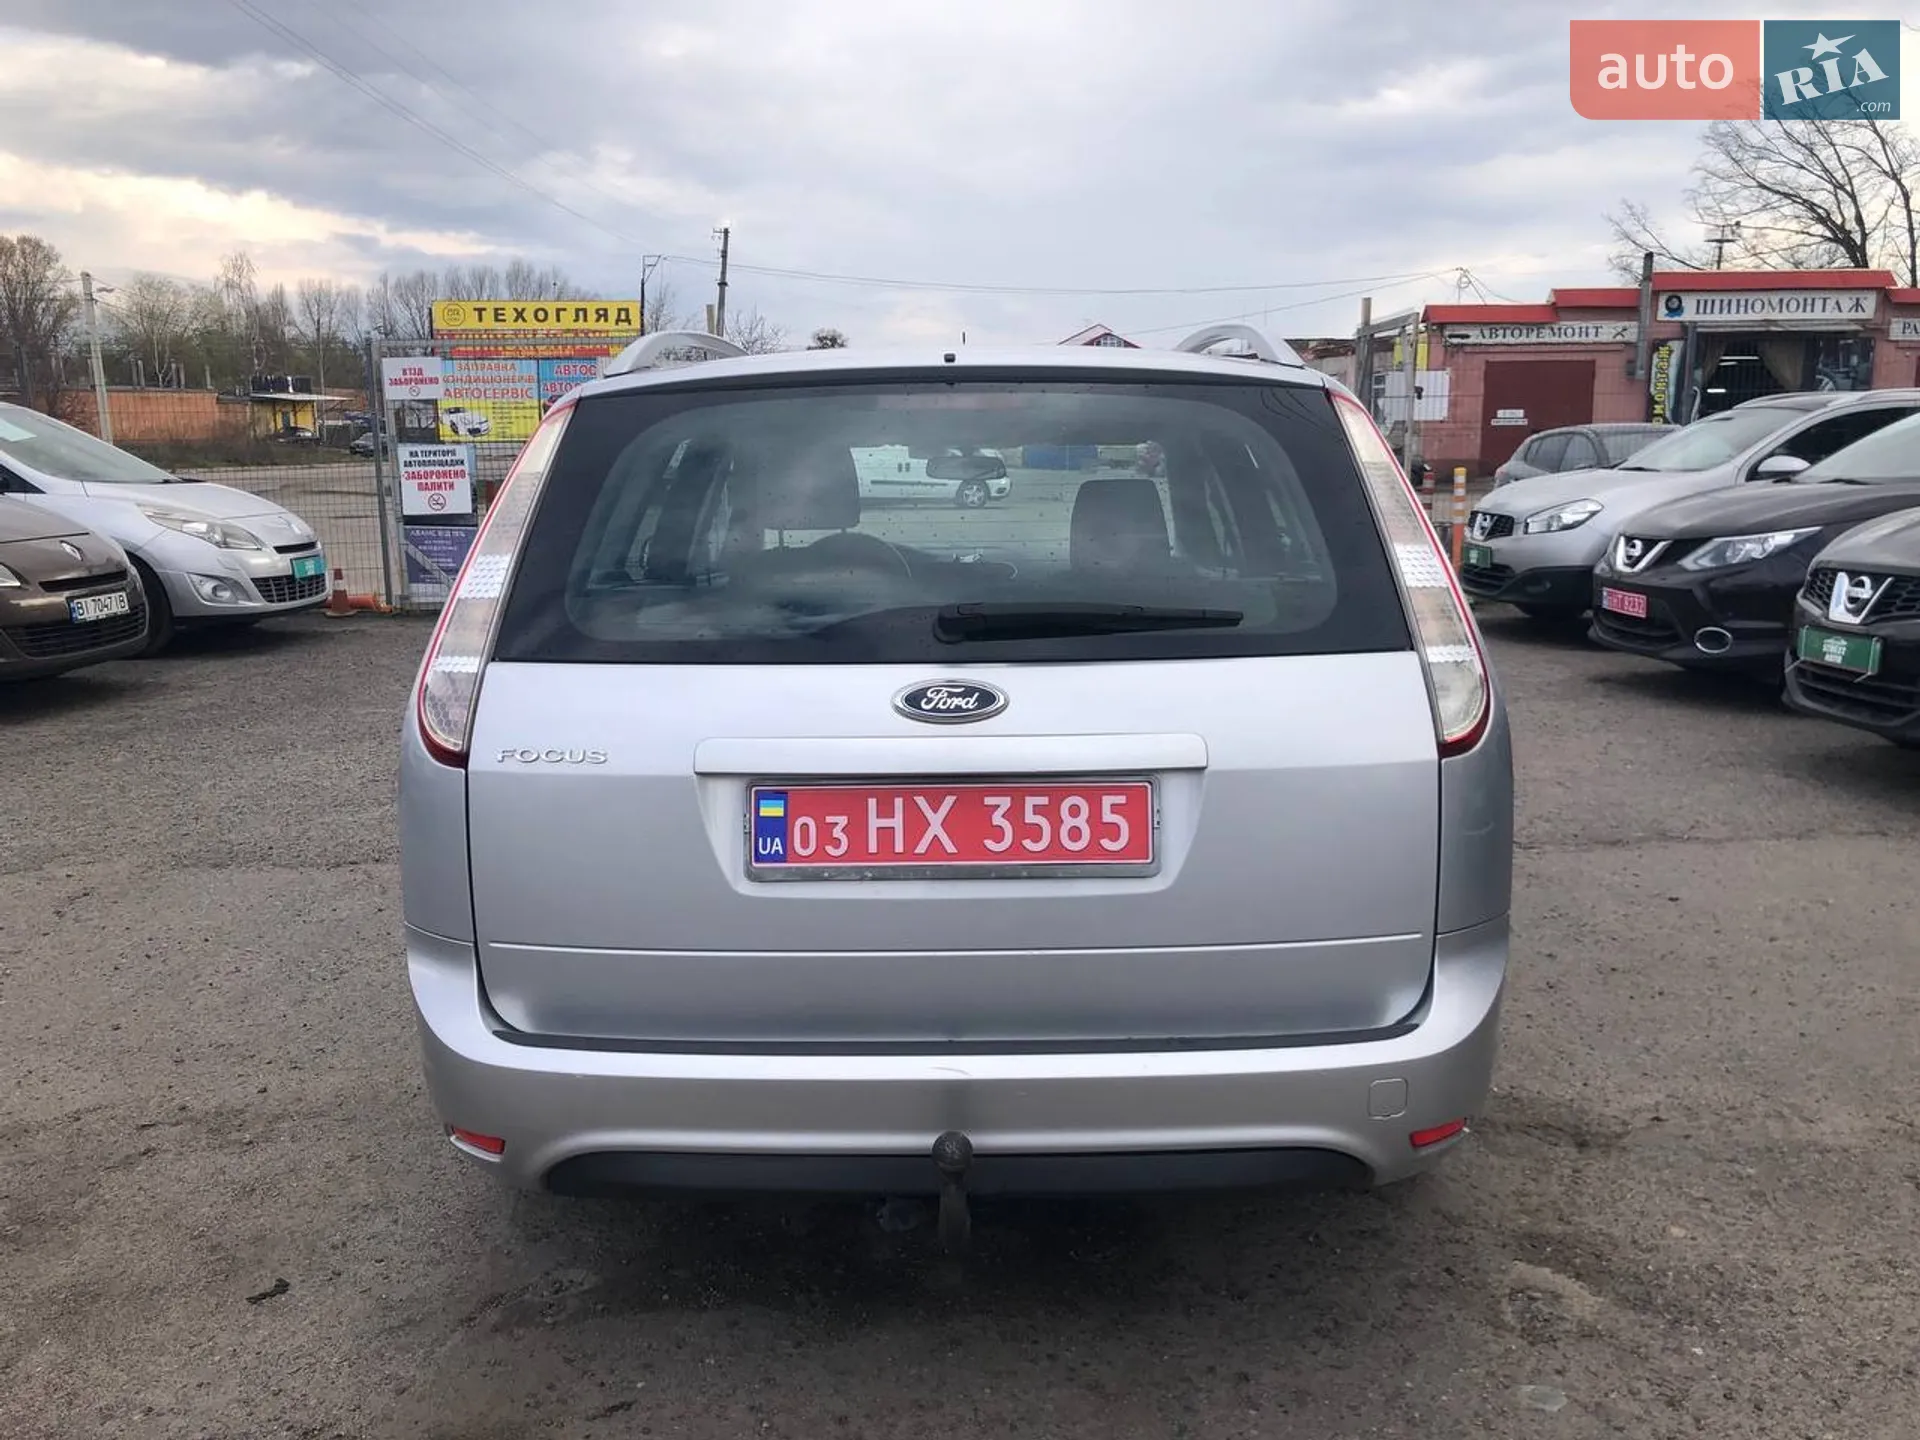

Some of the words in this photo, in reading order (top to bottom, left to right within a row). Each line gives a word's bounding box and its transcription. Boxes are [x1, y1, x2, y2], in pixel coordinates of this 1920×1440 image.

[1694, 296, 1868, 315] ШИНОМОНТАЖ
[473, 307, 632, 326] ТЕХОГЛЯД
[1477, 325, 1603, 340] АВТОРЕМОНТ
[443, 387, 534, 399] АВТОСЕРВІС
[404, 469, 467, 480] ЗАБОРОНЕНО
[417, 481, 455, 491] ПАЛИТИ
[920, 686, 979, 711] Ford
[496, 747, 608, 764] FOCUS
[793, 815, 849, 857] 03
[867, 794, 959, 855] HX
[983, 794, 1130, 853] 3585
[758, 836, 783, 855] UA
